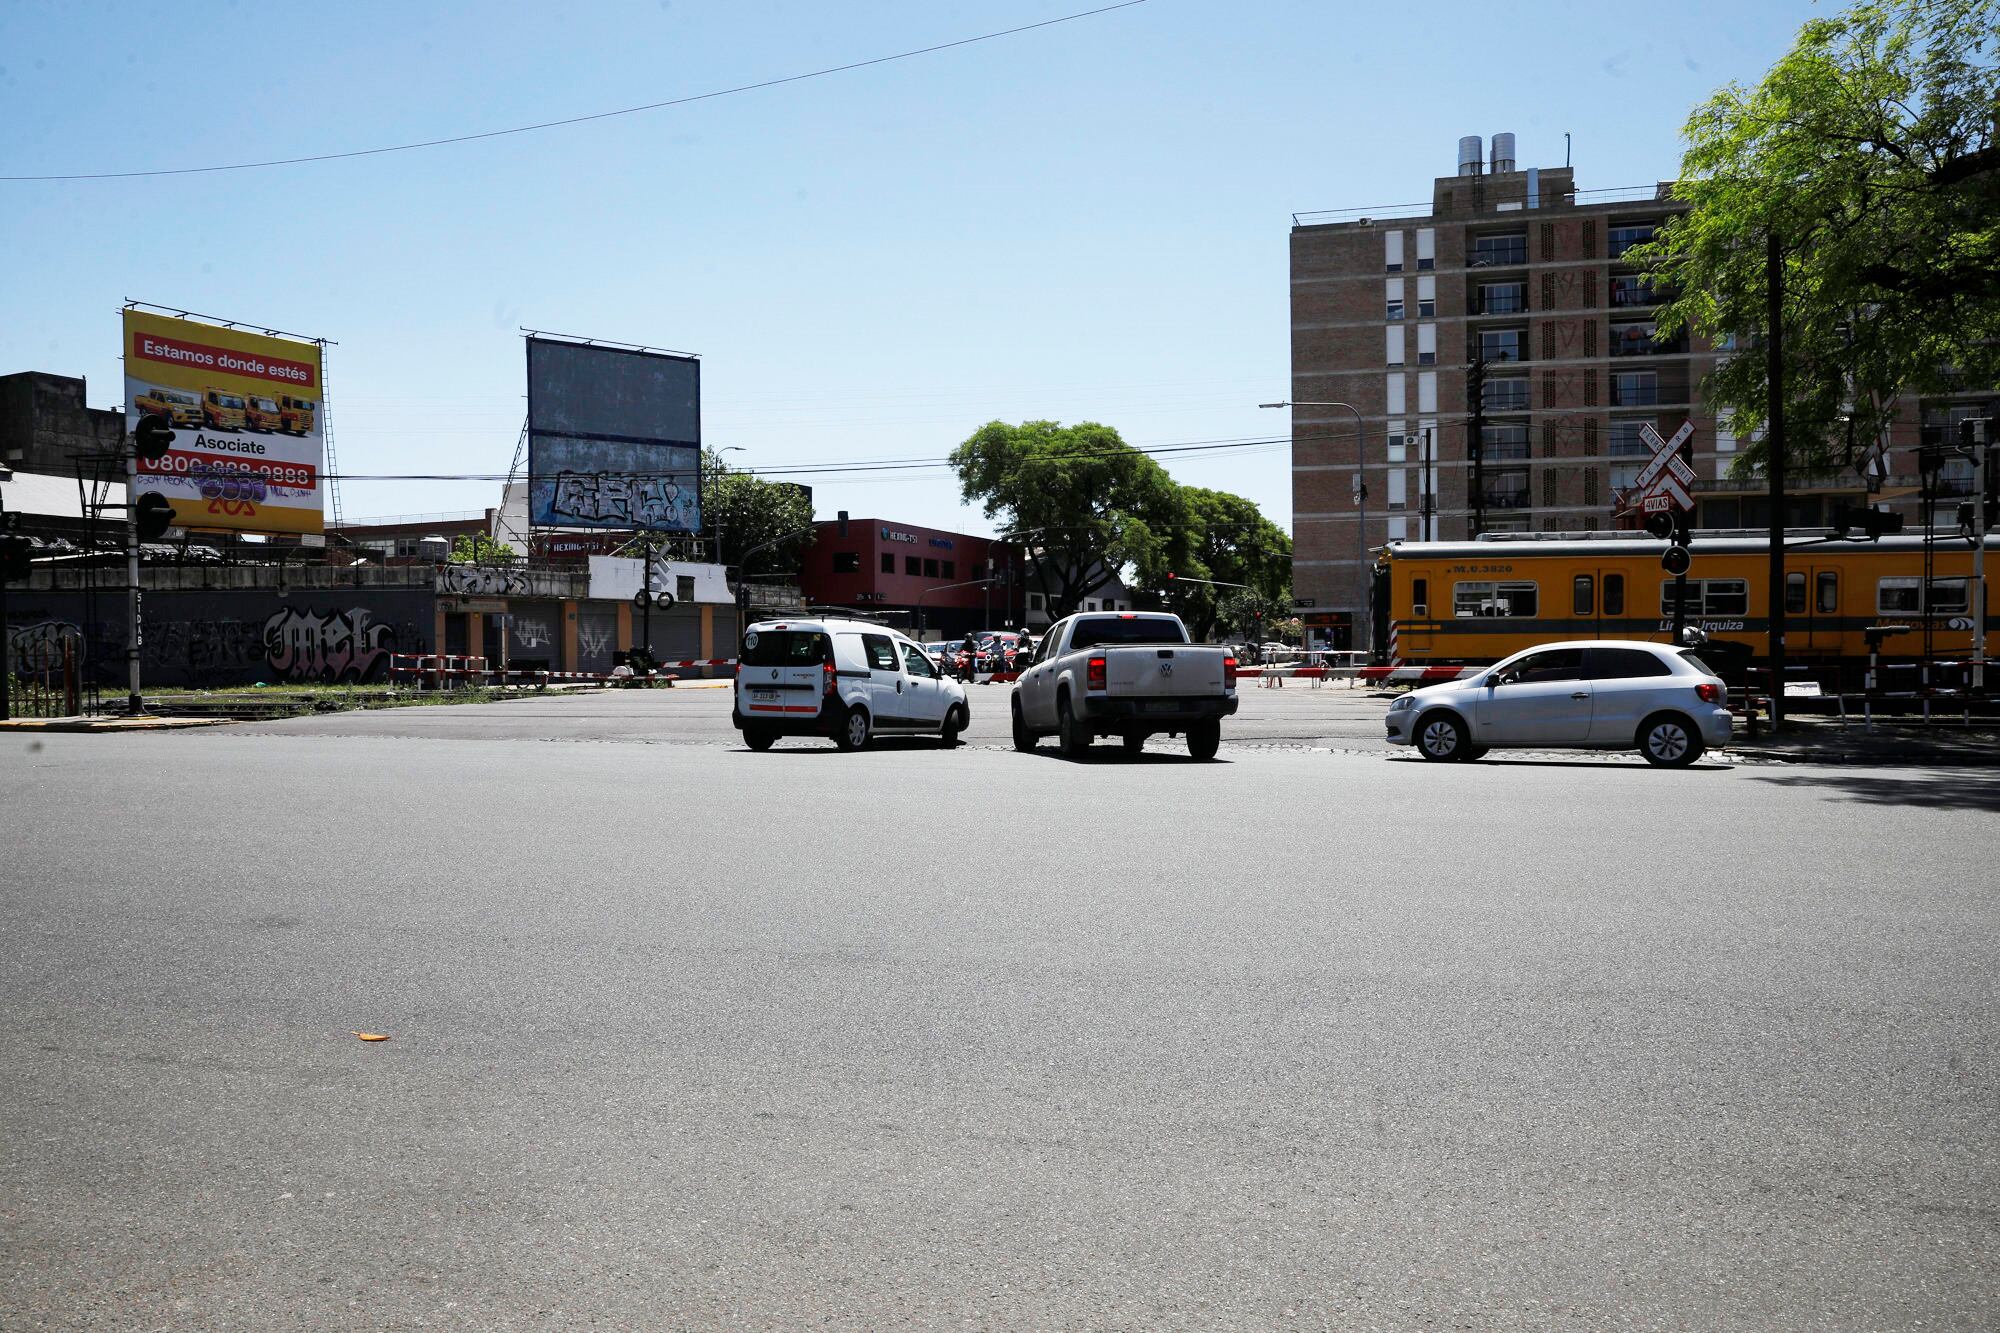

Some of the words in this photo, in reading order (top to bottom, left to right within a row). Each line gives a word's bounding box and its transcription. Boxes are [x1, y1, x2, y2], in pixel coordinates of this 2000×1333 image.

[144, 339, 214, 365] Estamos
[218, 354, 265, 374] donde
[268, 365, 307, 381] estés
[195, 434, 266, 455] Asociate
[1641, 427, 1689, 483] PELIGRO
[1696, 619, 1744, 632] Urquiza
[747, 635, 758, 646] 110
